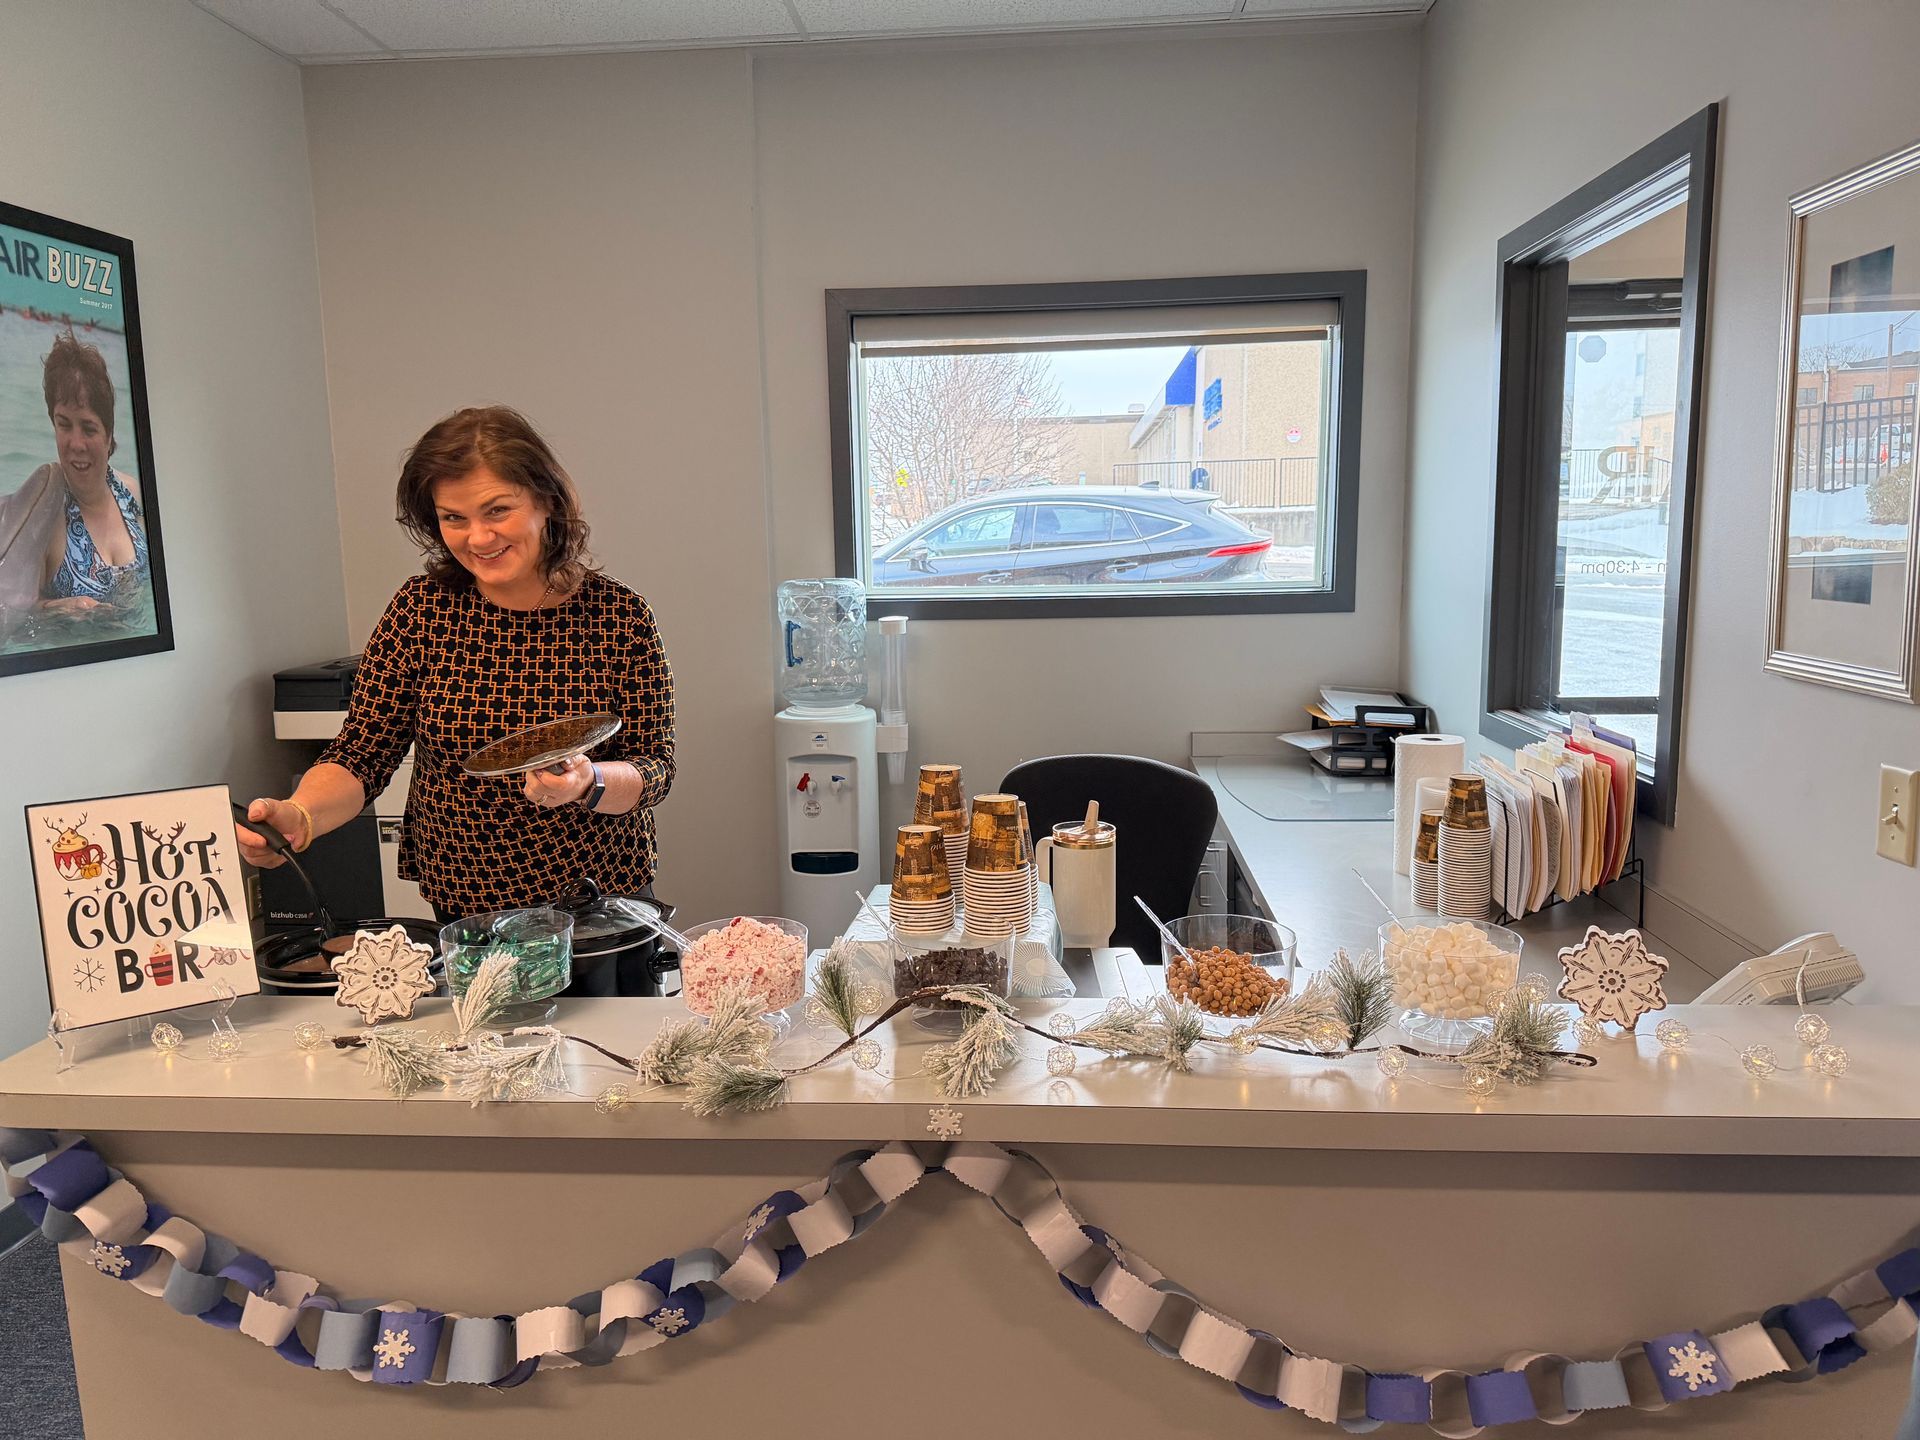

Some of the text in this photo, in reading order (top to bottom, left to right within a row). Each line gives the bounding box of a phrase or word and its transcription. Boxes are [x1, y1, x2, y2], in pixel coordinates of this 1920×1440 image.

[47, 246, 113, 296] BUZZ
[80, 298, 100, 308] Summer
[102, 820, 218, 890] HOT
[67, 876, 237, 950] COCOA
[270, 911, 294, 919] bizhub
